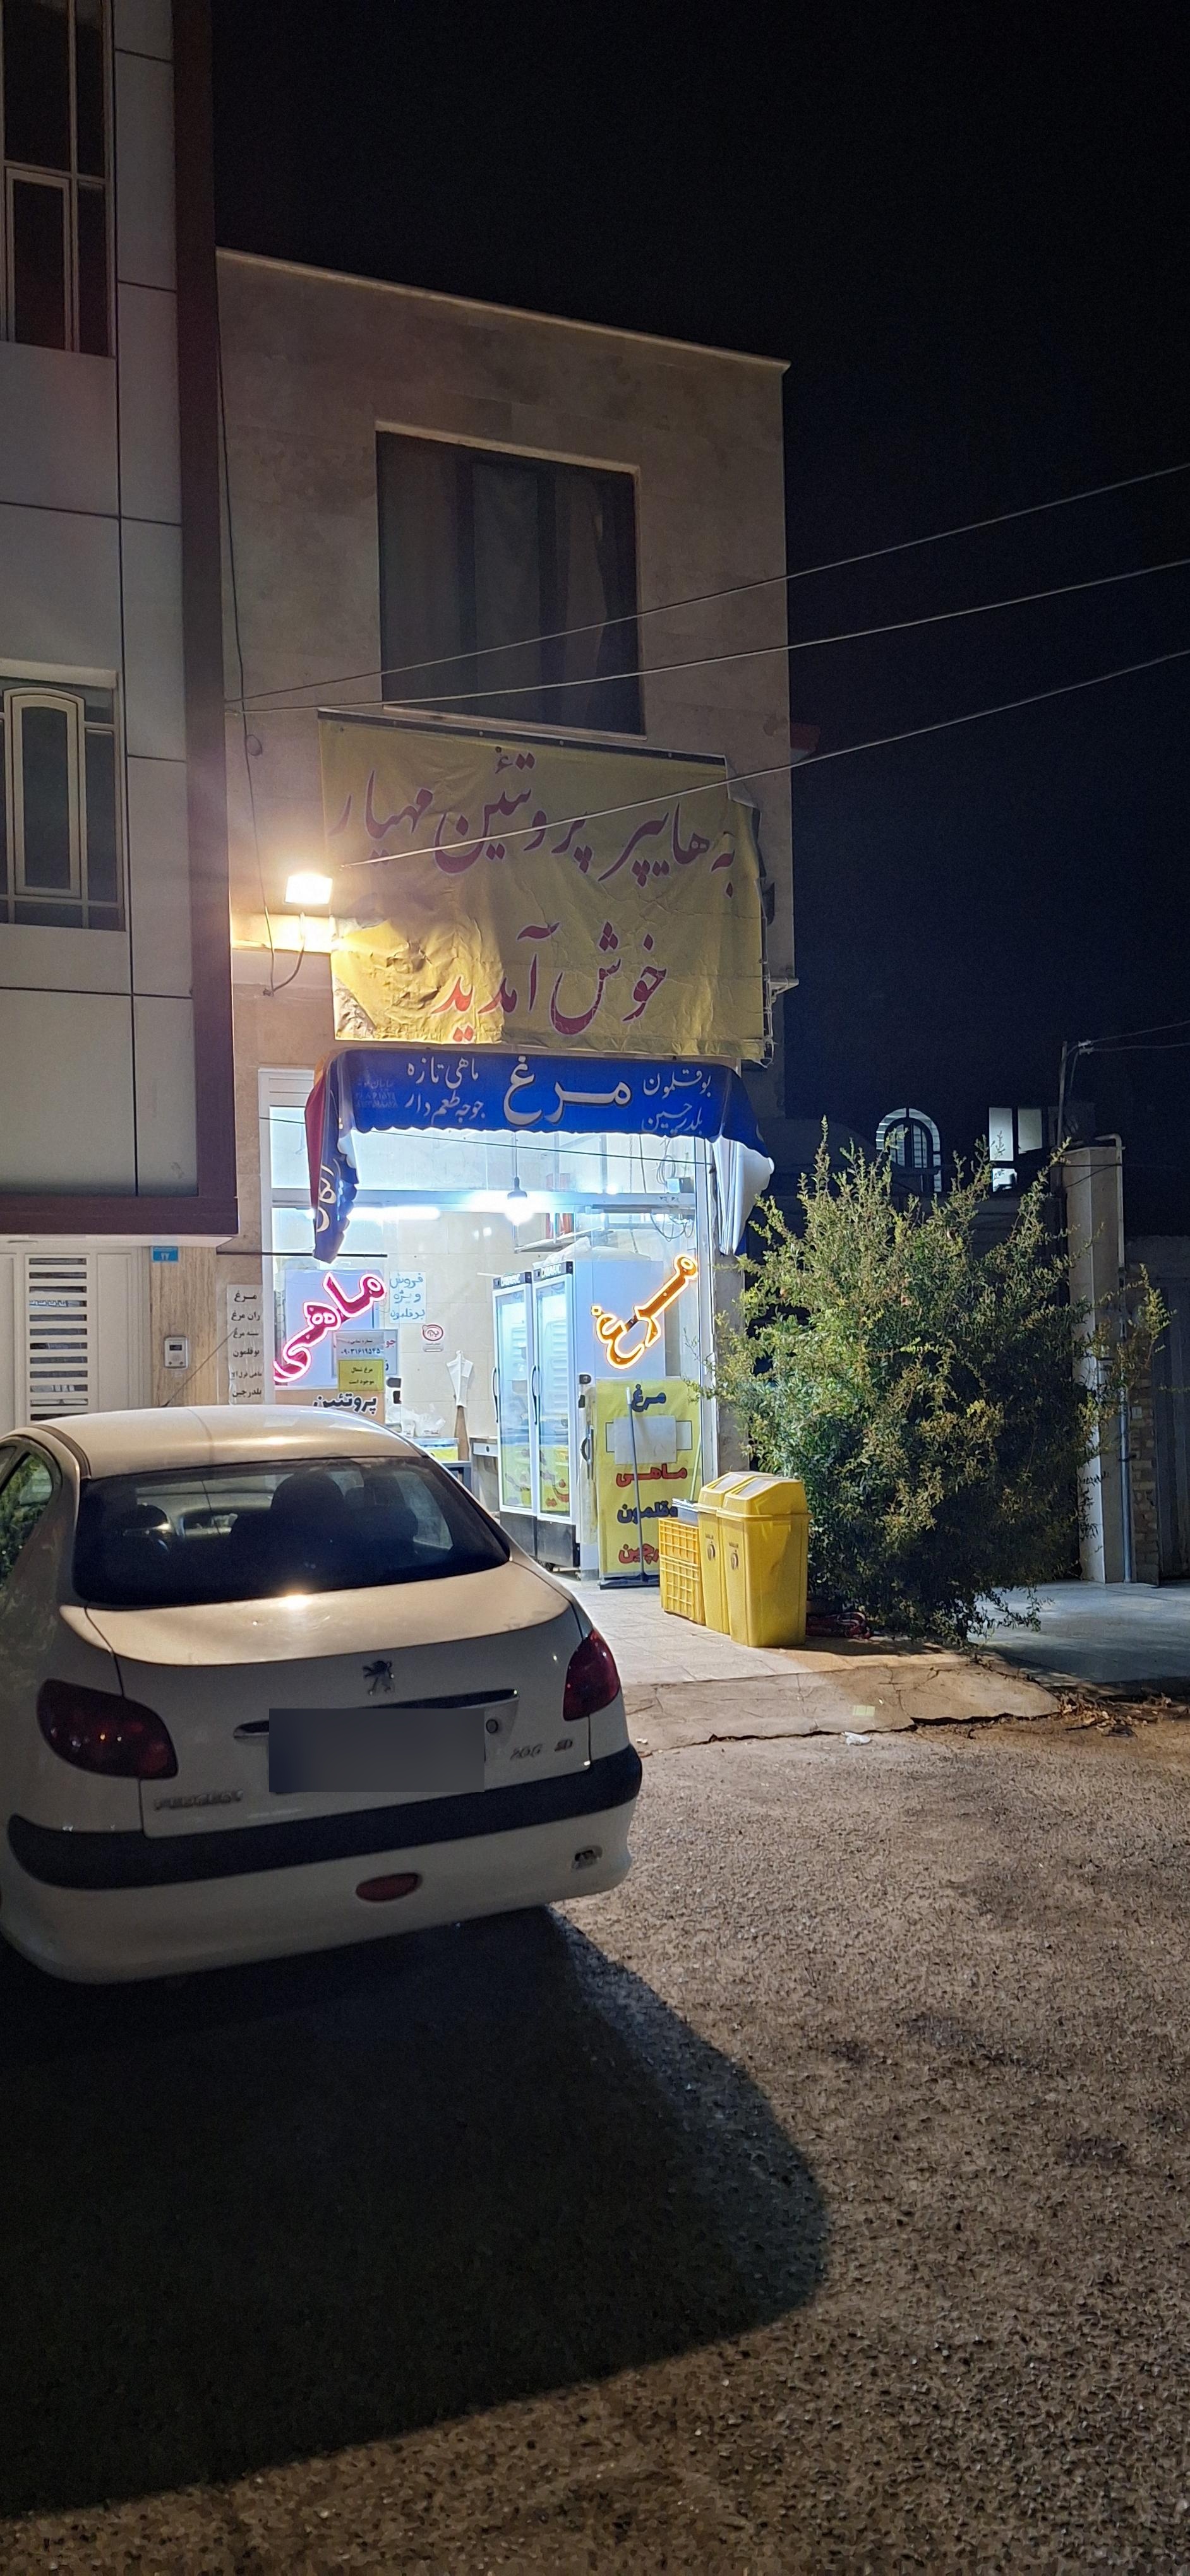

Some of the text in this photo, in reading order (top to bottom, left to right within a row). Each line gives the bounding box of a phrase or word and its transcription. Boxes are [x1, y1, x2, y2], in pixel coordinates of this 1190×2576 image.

[328, 751, 736, 898] به هایپر پروتئین مهیار
[430, 920, 667, 1043] خوش آمدید
[407, 1056, 479, 1089] ماهی تازه
[643, 1069, 711, 1100] بوقلمون
[504, 1055, 633, 1126] مرغ
[404, 1092, 431, 1118] دار
[455, 1100, 486, 1123] جوجه
[389, 1272, 424, 1289] فروش
[234, 1290, 257, 1303] مرغ
[231, 1309, 261, 1321] ران مرغ
[591, 1253, 699, 1369] مرغ
[233, 1327, 245, 1339] مرغ
[273, 1271, 387, 1383] ماهی
[632, 1384, 666, 1412] مرغ
[616, 1464, 688, 1488] ماهی
[617, 1501, 678, 1525] وقلمون
